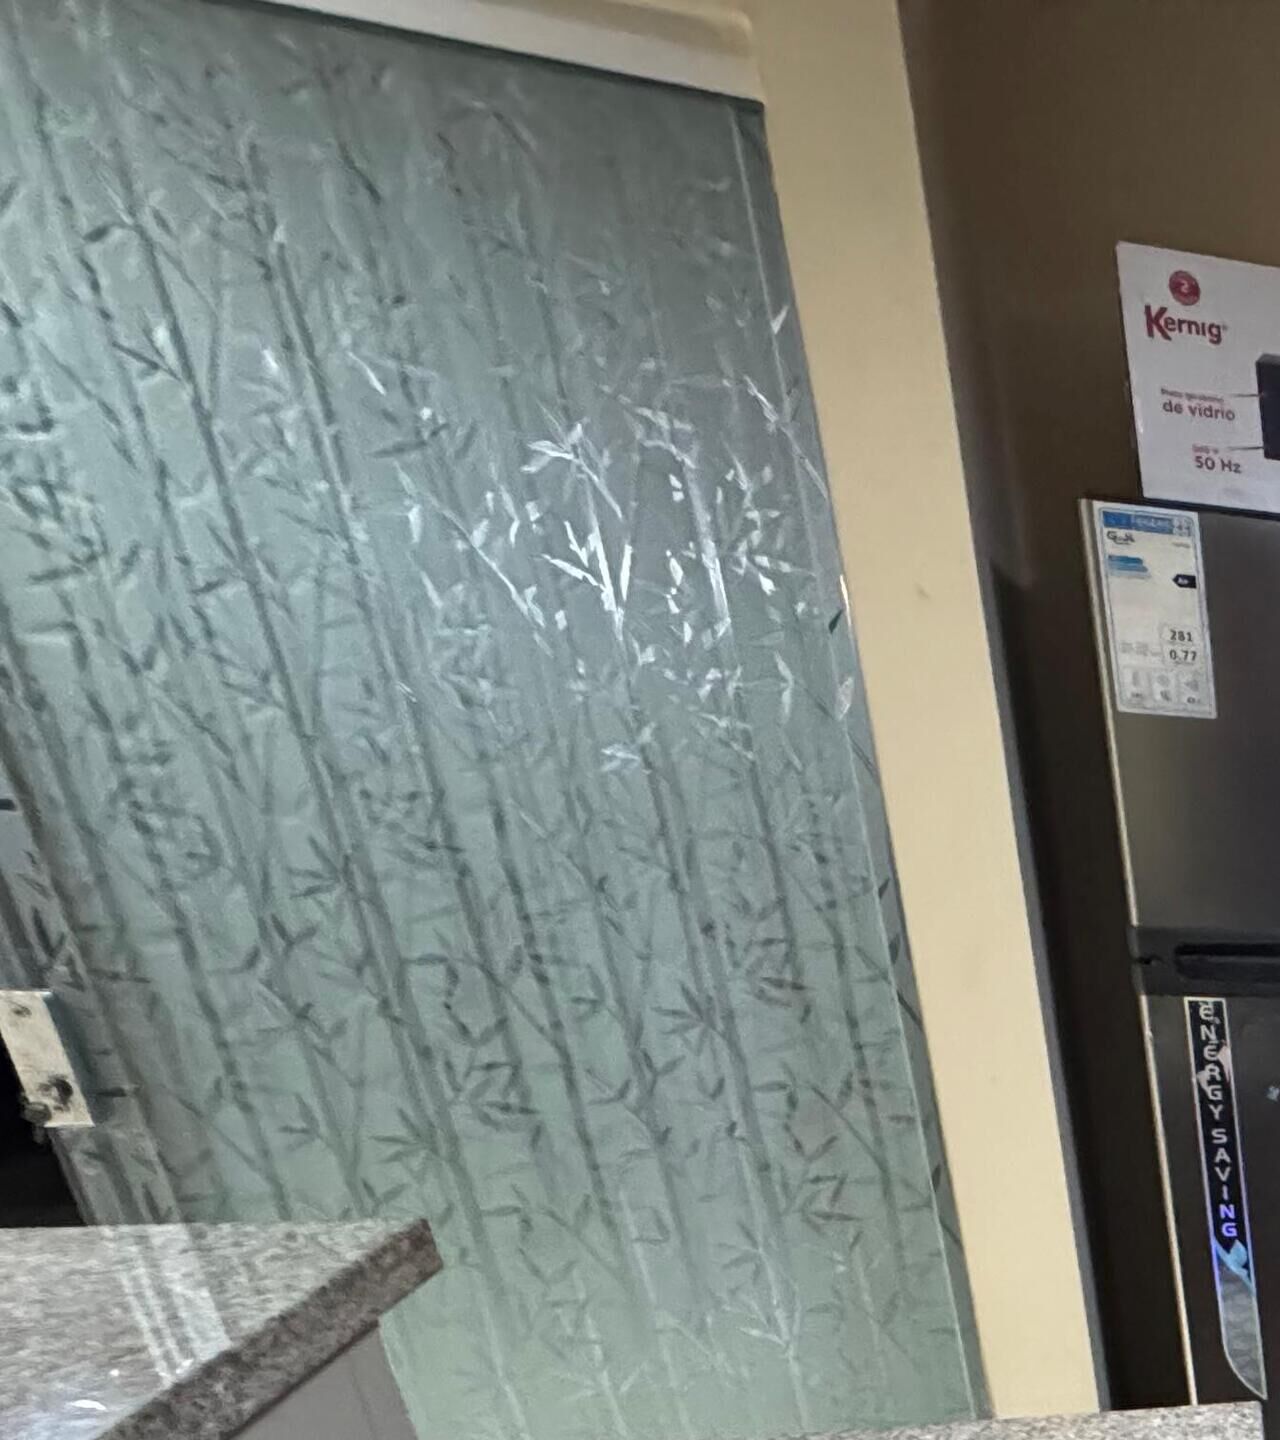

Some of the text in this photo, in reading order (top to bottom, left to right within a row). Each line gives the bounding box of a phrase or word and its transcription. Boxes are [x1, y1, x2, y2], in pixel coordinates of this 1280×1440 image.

[1144, 304, 1222, 345] Kernig
[1162, 400, 1236, 421] de vidrio
[1195, 456, 1242, 474] 50 Hz
[1211, 1128, 1238, 1237] SAVING
